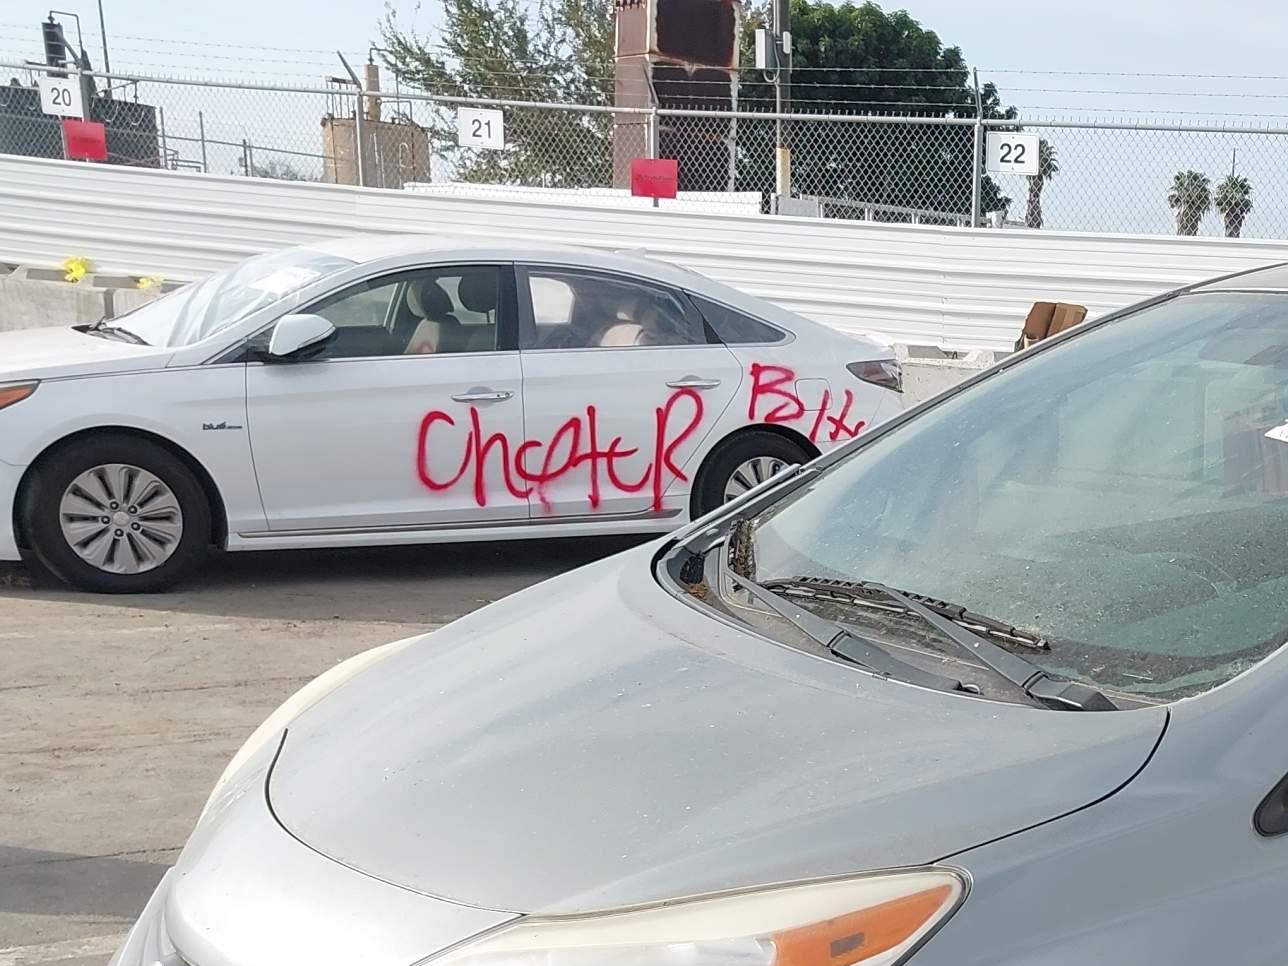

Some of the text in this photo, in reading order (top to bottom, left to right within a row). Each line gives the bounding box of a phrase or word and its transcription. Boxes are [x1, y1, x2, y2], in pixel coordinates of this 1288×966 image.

[51, 87, 72, 107] 20
[471, 118, 492, 139] 21
[999, 143, 1026, 164] 22
